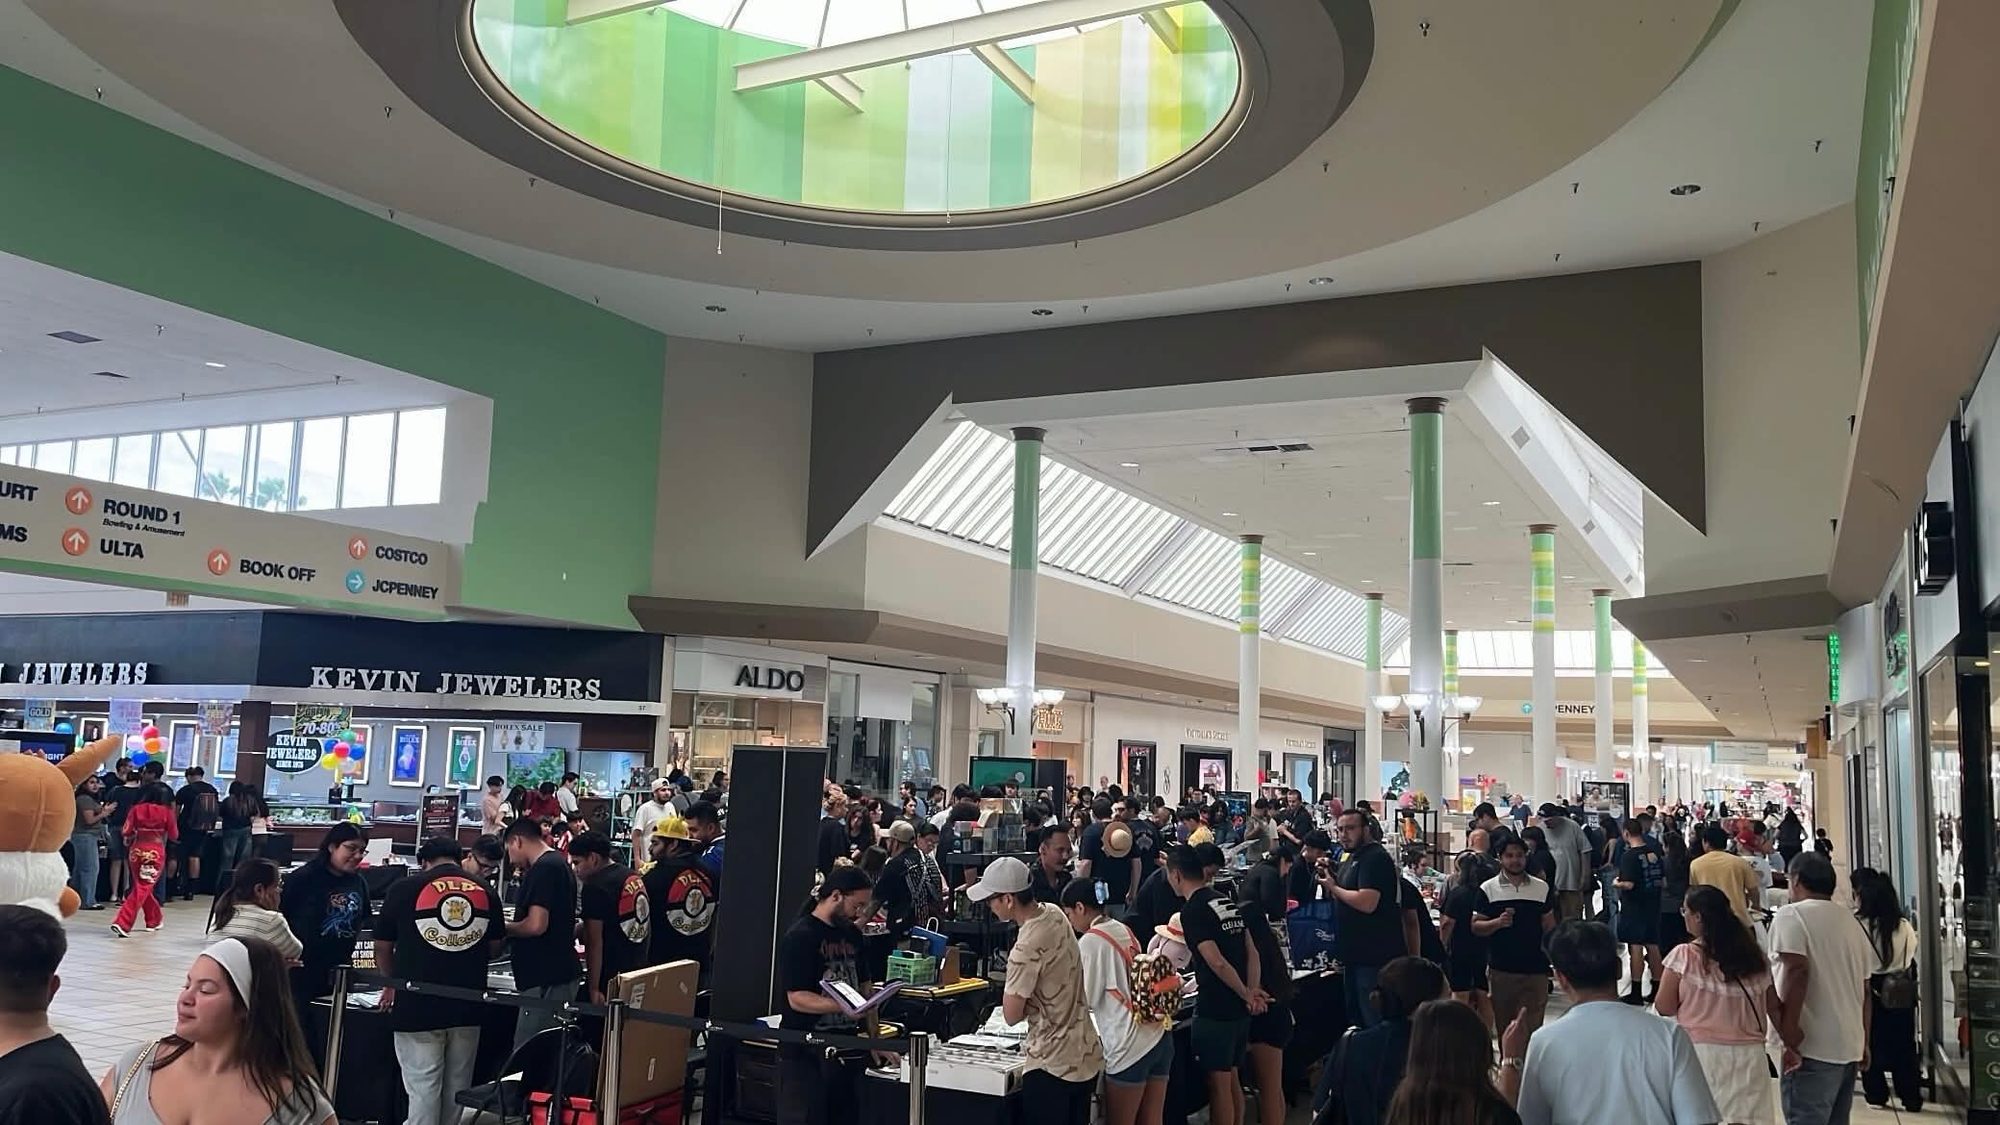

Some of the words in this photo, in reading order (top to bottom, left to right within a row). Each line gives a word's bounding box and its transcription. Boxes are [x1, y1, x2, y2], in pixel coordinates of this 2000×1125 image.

[103, 499, 168, 523] ROUND
[172, 511, 181, 525] 1
[102, 518, 134, 532] Bowling
[135, 523, 141, 532] &
[142, 523, 185, 538] Amusement
[100, 538, 144, 560] ULTA
[375, 545, 428, 566] COSTCO
[239, 559, 284, 579] BOOK
[287, 567, 316, 582] OFF
[372, 579, 439, 600] JCPENNEY
[19, 662, 148, 685] JEWELERS
[310, 666, 420, 693] KEVIN
[436, 672, 601, 700] JEWELERS
[735, 664, 805, 692] ALDO
[30, 707, 51, 718] GOLD
[1555, 704, 1596, 714] ENNEY
[521, 724, 544, 732] SALE
[276, 734, 308, 747] KEVIN
[266, 747, 317, 761] JEWELERS
